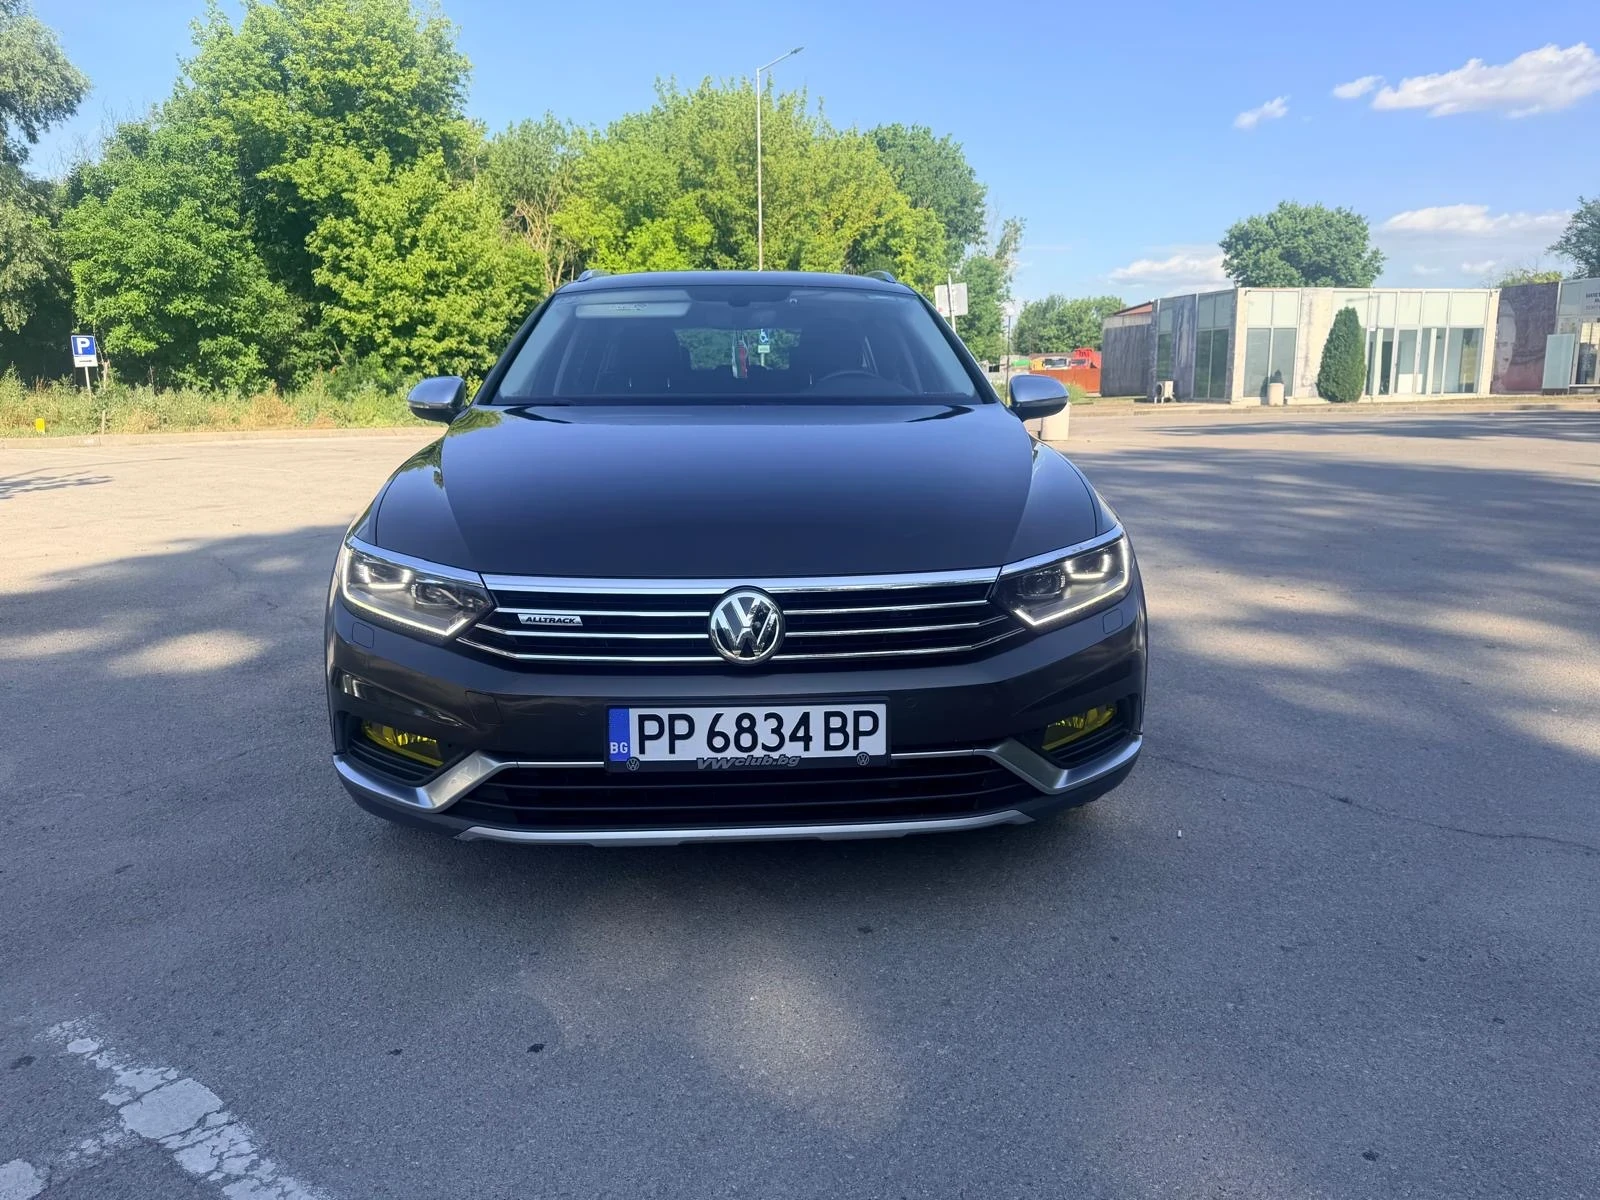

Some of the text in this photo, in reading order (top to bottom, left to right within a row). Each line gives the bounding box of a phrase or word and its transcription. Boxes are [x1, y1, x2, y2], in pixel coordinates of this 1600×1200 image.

[76, 337, 90, 355] P
[525, 616, 576, 624] ALLTRACK
[637, 710, 880, 755] PP 6834 BP
[609, 741, 629, 754] BG
